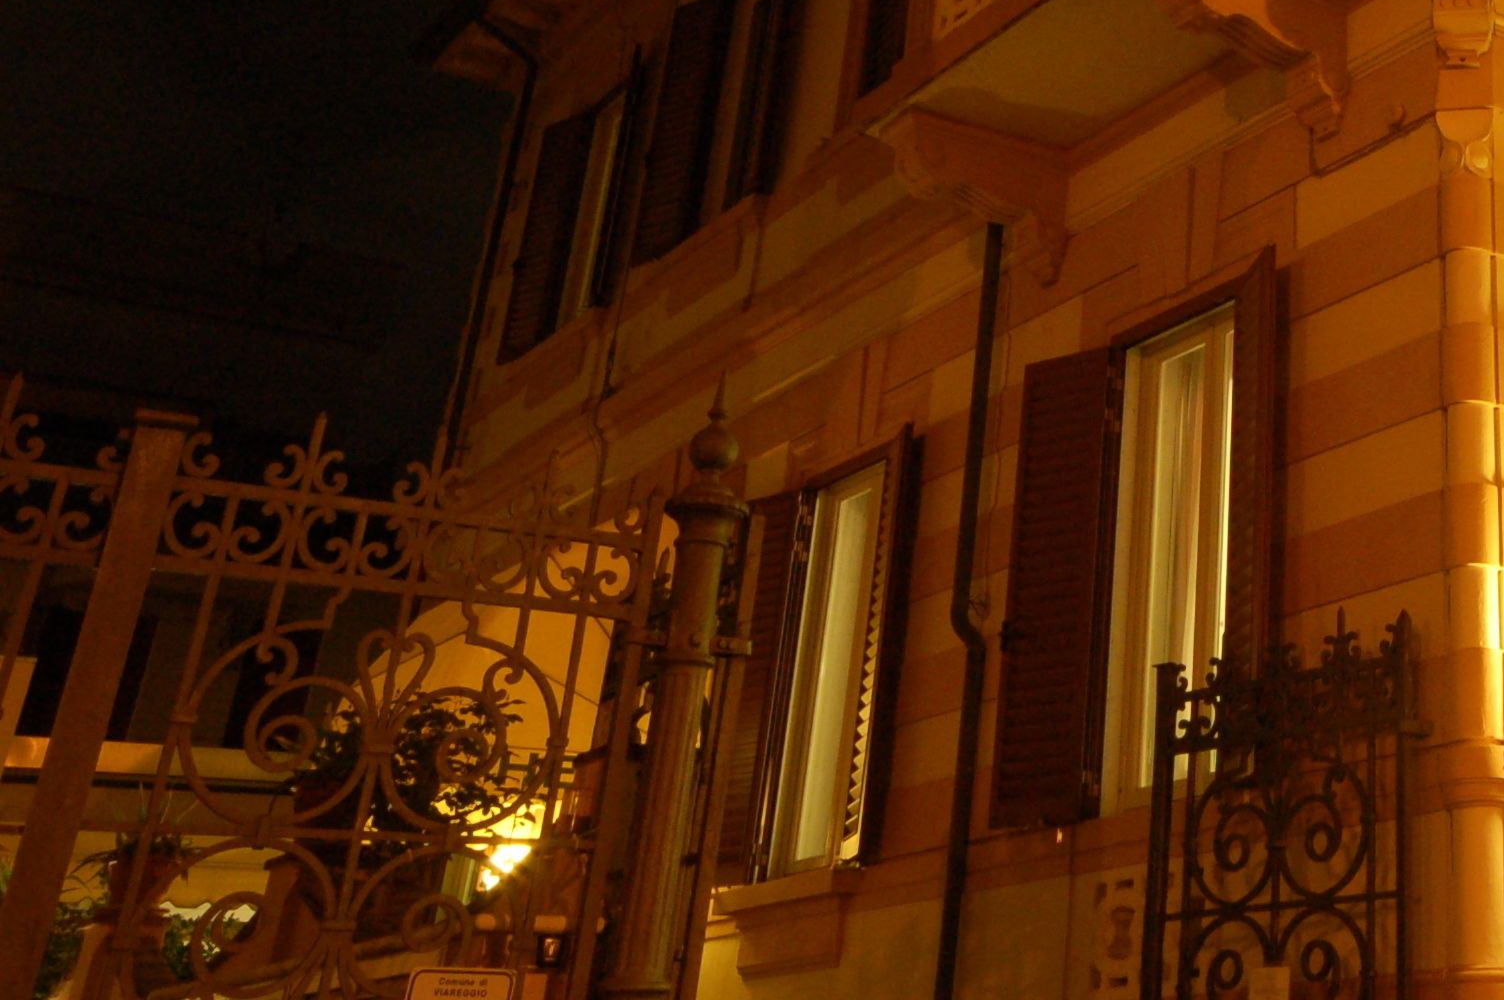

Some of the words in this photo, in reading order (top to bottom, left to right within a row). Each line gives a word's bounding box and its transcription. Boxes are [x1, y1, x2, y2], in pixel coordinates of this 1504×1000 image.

[438, 977, 475, 986] Comune
[479, 978, 488, 986] di
[434, 988, 488, 997] VIAREGGIO
